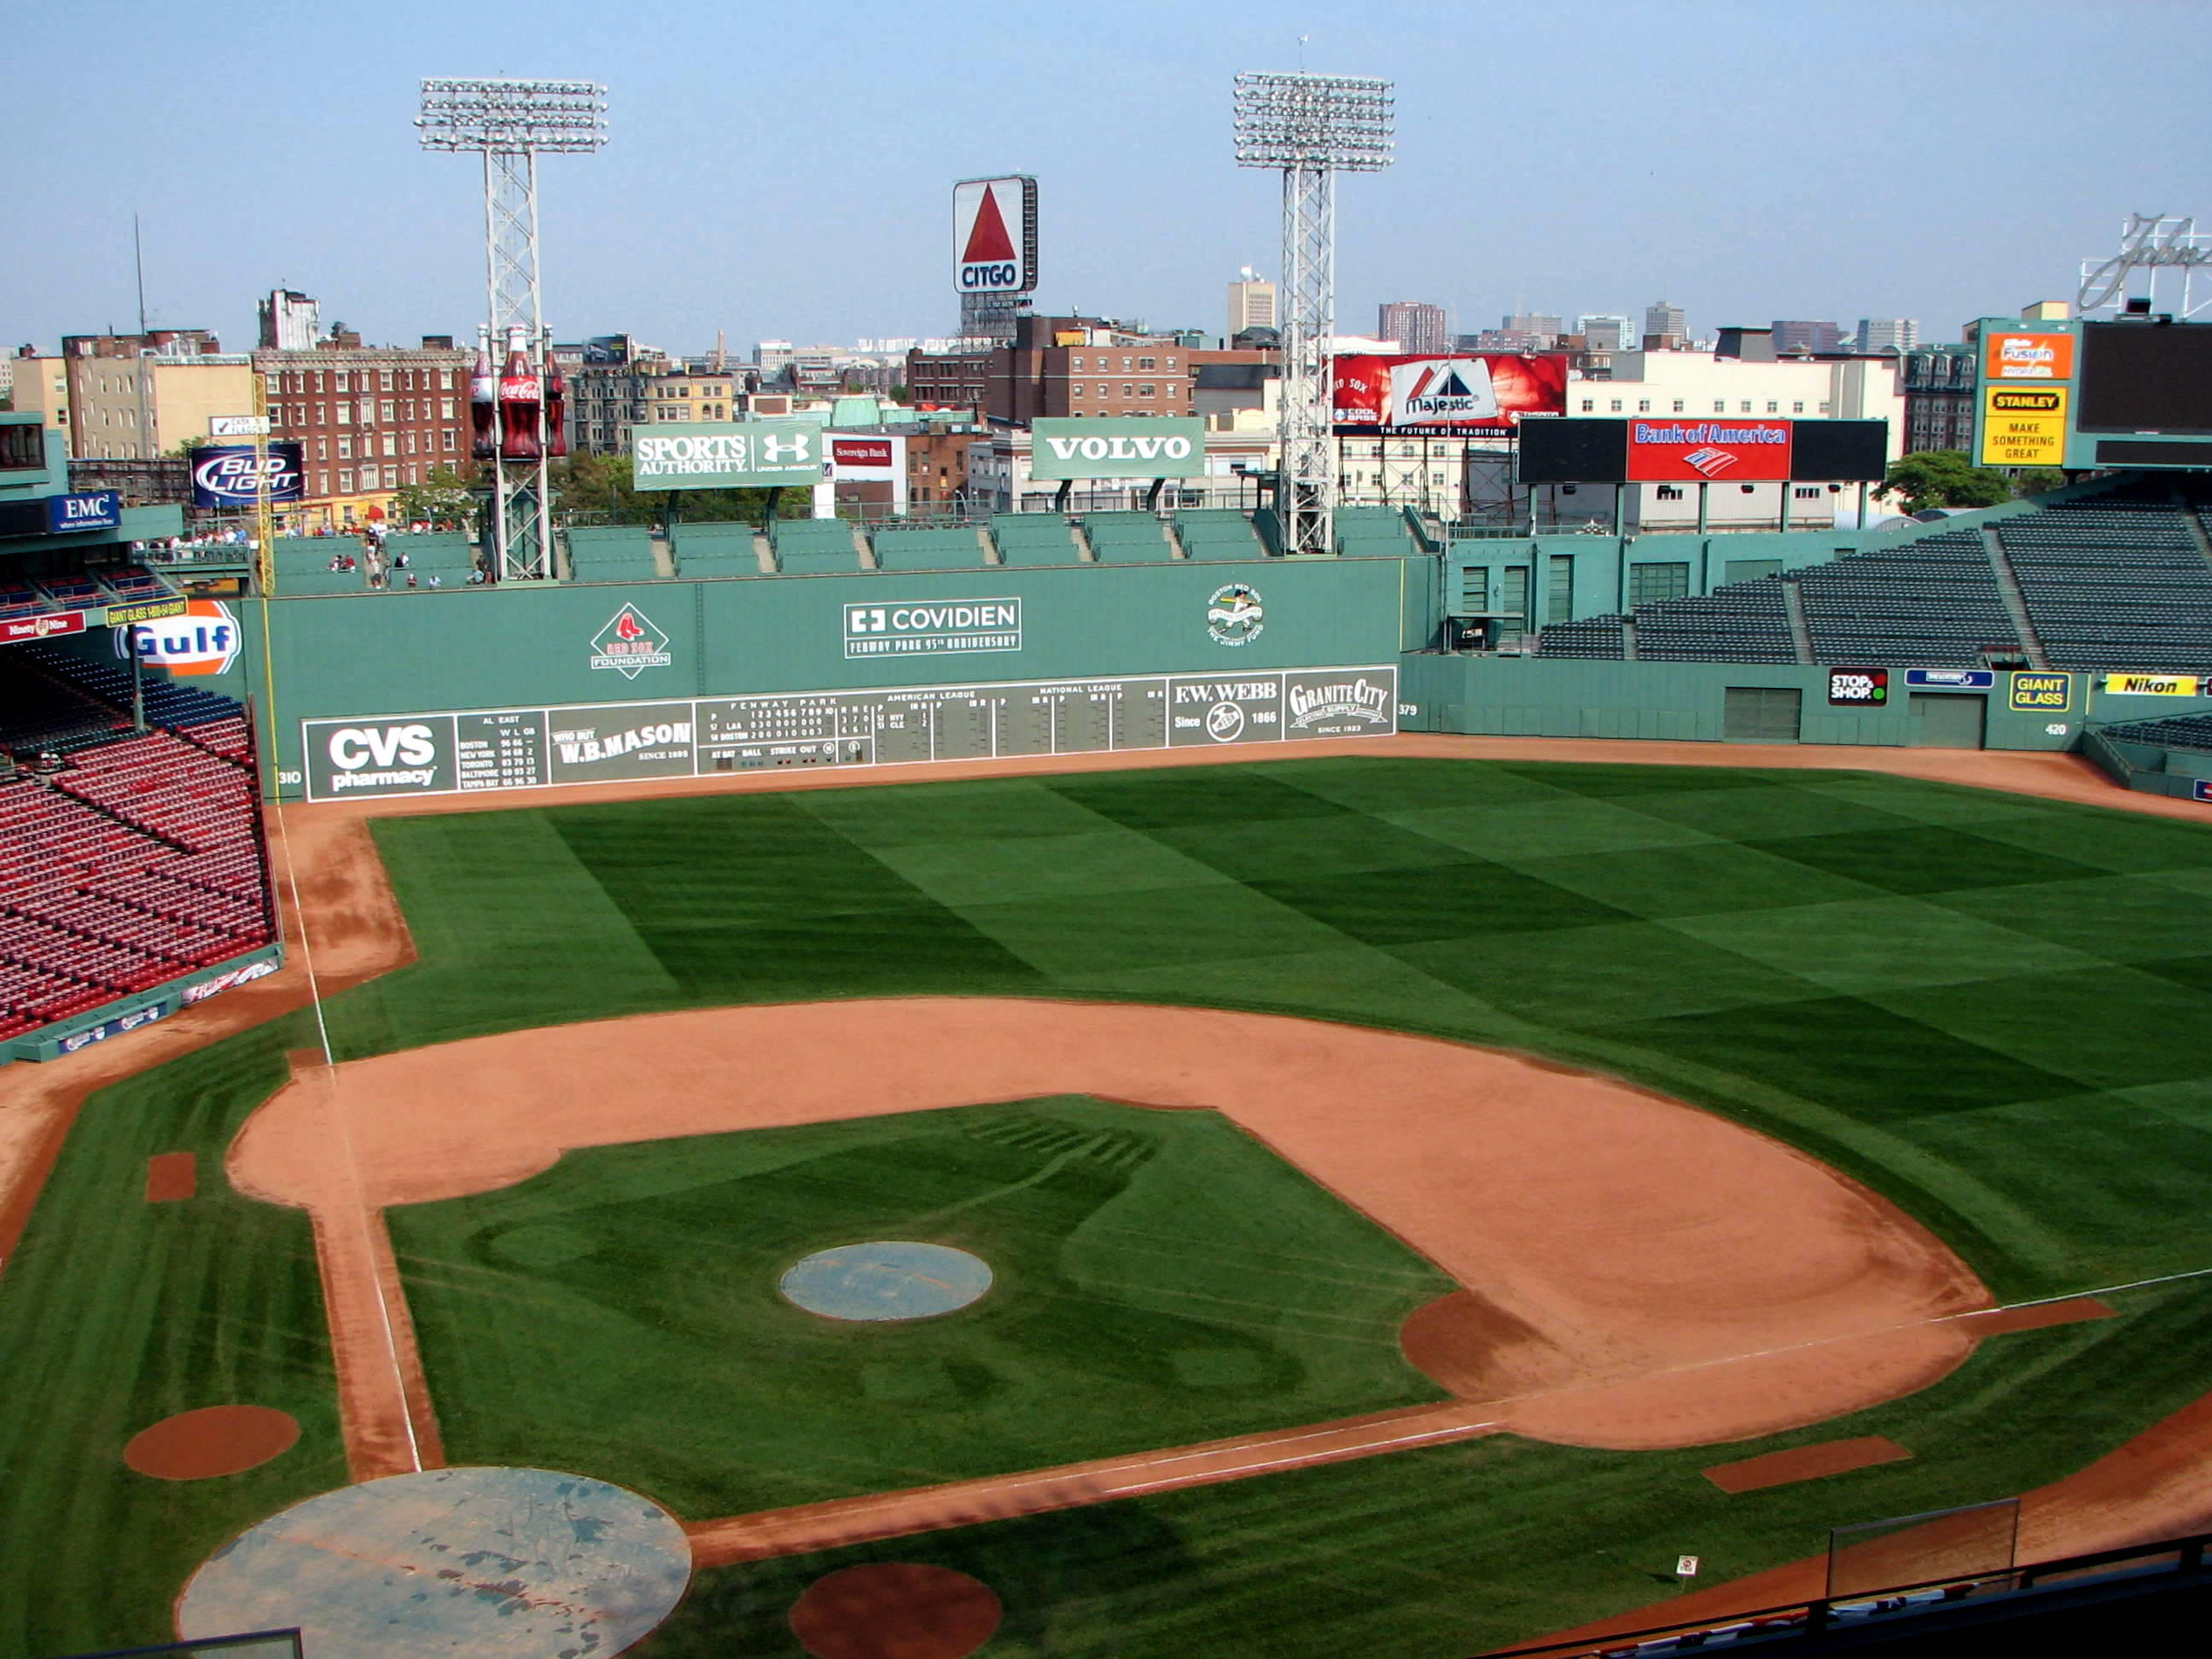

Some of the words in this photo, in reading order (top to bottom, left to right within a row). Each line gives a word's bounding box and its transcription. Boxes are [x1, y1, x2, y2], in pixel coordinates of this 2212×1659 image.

[962, 264, 1016, 288] CITGO
[1349, 378, 1368, 393] SOX
[1406, 396, 1474, 416] Majestic
[1997, 396, 2056, 408] STANLEY
[1401, 427, 1436, 435] FUTURE
[1635, 423, 1685, 444] Bank
[1686, 423, 1707, 444] of
[1709, 423, 1786, 444] America
[2008, 422, 2040, 434] MAKE
[1993, 435, 2055, 446] SOMETHING
[638, 435, 747, 461] SPORTS
[836, 448, 868, 459] Sovereign
[869, 448, 888, 457] Bank
[1045, 436, 1191, 460] VOLVO
[2005, 449, 2039, 459] GREAT
[220, 458, 287, 475] BUD
[639, 459, 745, 475] AUTHORITY
[208, 472, 299, 492] LIGHT
[892, 605, 1015, 631] COVIDIEN
[125, 626, 230, 655] Gulf
[594, 655, 668, 667] FOUNDATION
[1831, 675, 1869, 687] STOP
[2017, 678, 2065, 691] GIANT
[2124, 678, 2178, 693] Nikon
[1039, 686, 1084, 695] NATIONAL
[1087, 684, 1122, 693] LEAGUE
[1174, 684, 1214, 703] F.W.
[1215, 682, 1278, 701] WEBB
[1831, 687, 1871, 699] SHOP
[888, 693, 935, 702] AMERICAN
[940, 690, 975, 700] LEAGUE
[2015, 692, 2064, 705] GLASS
[731, 701, 789, 710] FENWAY
[800, 698, 837, 707] PARK
[1398, 704, 1417, 716] 379
[498, 716, 520, 725] EAST
[1174, 716, 1201, 728] Since
[1251, 711, 1277, 724] 1866
[1318, 725, 1341, 734] SINCE
[2046, 724, 2066, 736] 420
[552, 731, 575, 742] WHO
[577, 730, 595, 741] BUT
[329, 725, 435, 770] CVS
[460, 740, 488, 750] BOSTON
[742, 748, 762, 757] BALL
[770, 746, 797, 756] STRIKE
[800, 745, 817, 754] OUT
[460, 751, 476, 760] NEW
[638, 752, 667, 760] SINCE
[461, 760, 493, 769] TORONTO
[279, 771, 301, 784] 310
[461, 769, 499, 778] BALTIMORE
[332, 769, 434, 792] pharmacy
